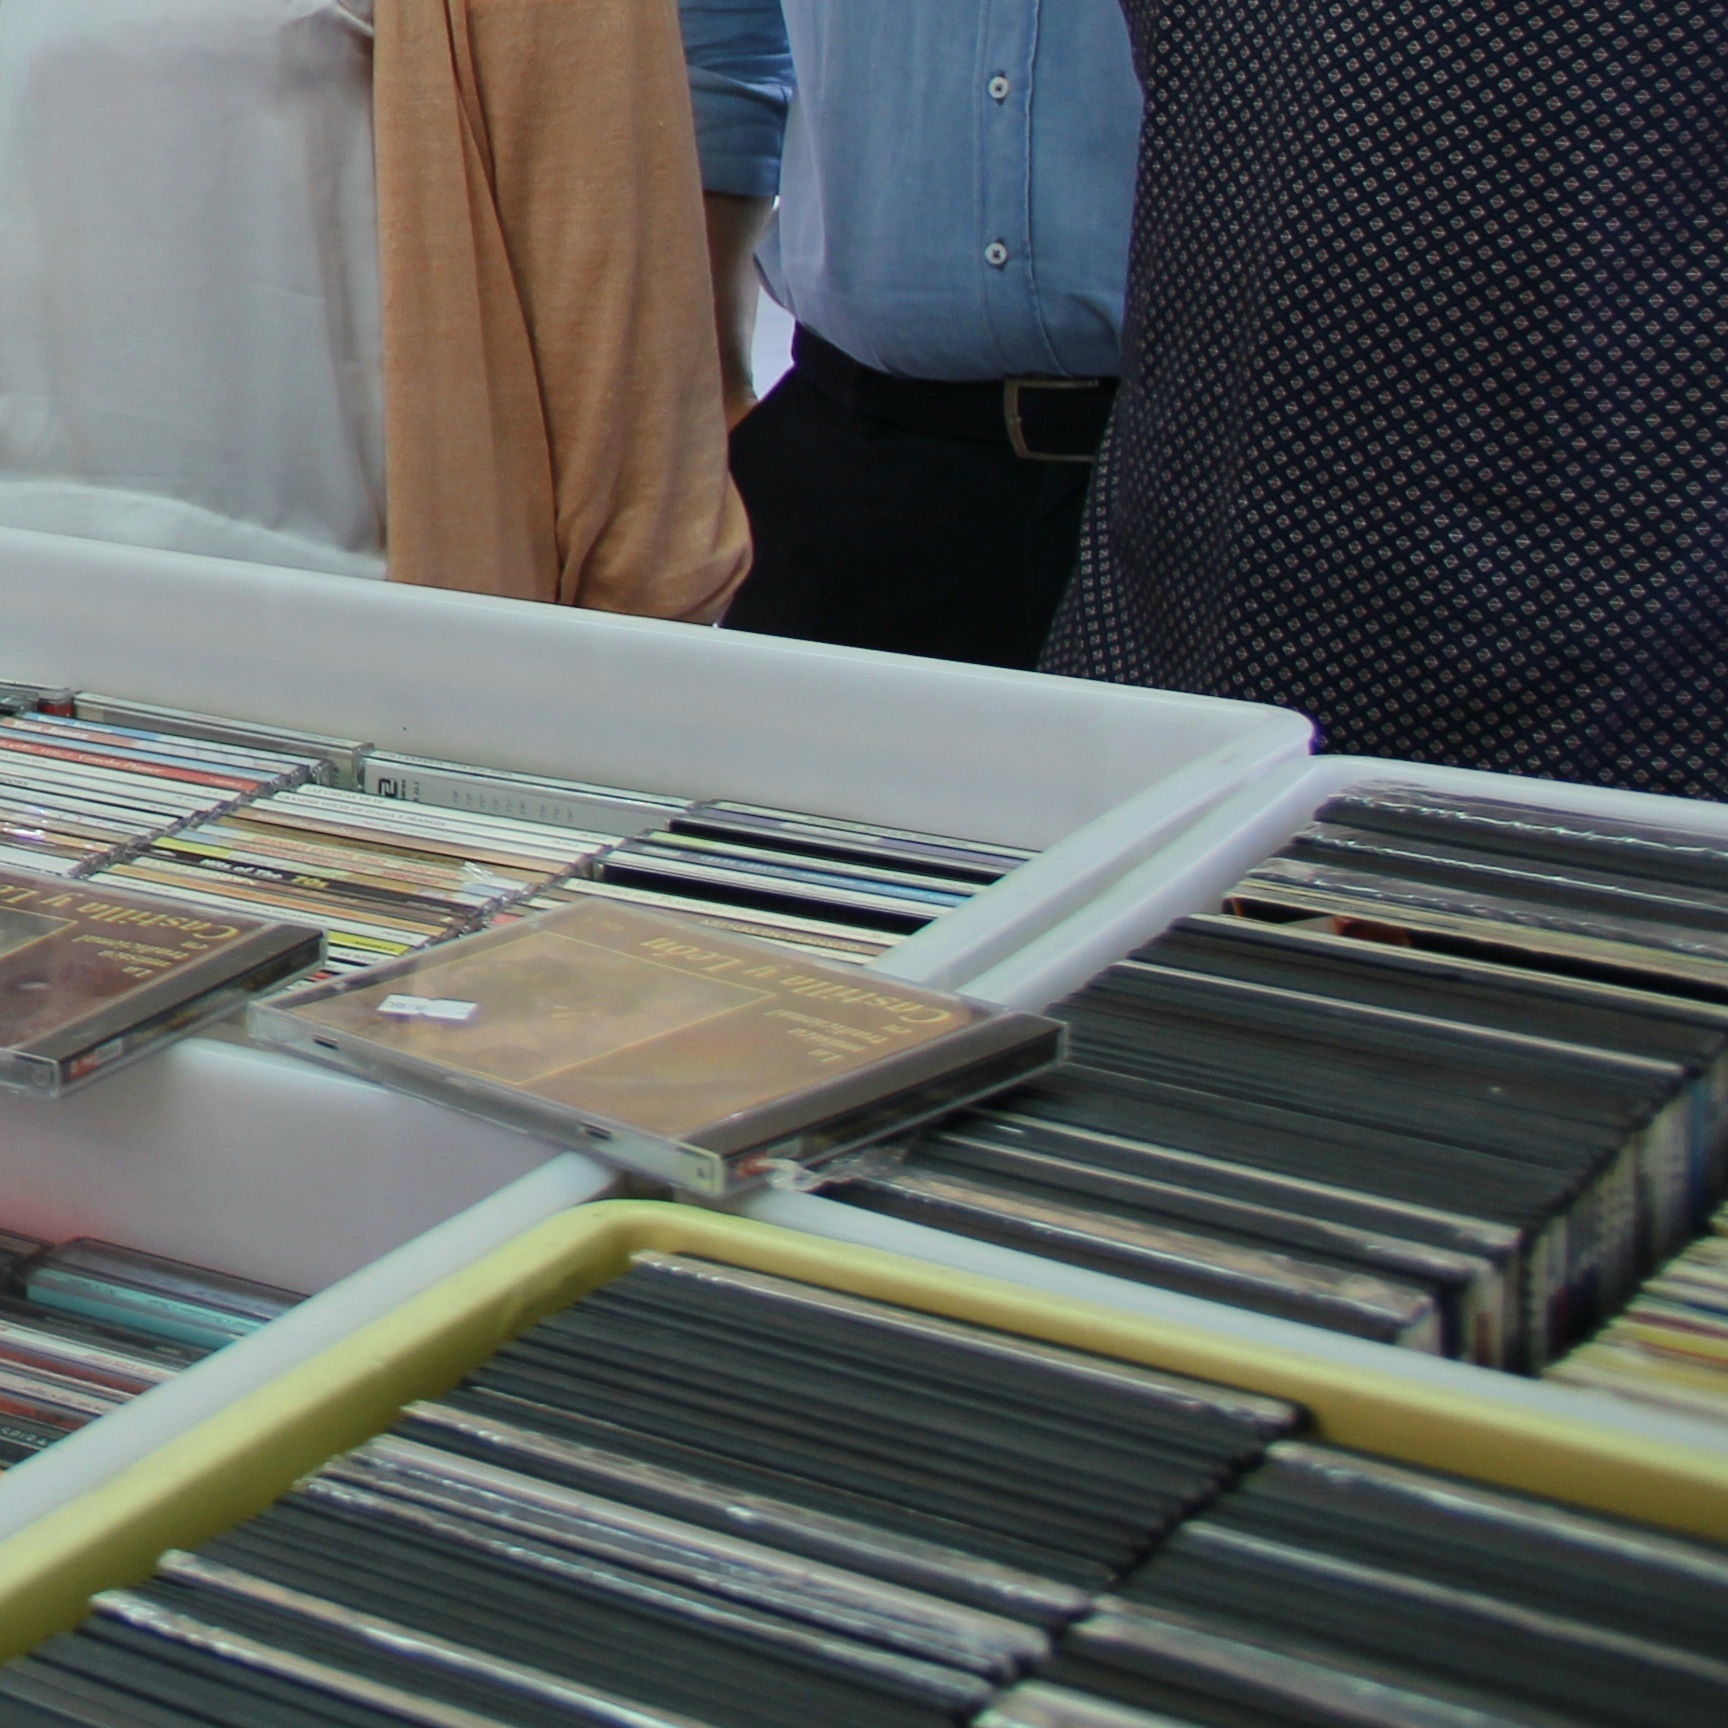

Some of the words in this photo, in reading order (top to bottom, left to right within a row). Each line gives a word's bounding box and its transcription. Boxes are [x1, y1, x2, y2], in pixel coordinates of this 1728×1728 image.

[40, 890, 86, 910] y
[76, 900, 244, 942] Castilla
[640, 935, 744, 973] León
[741, 962, 791, 979] y
[779, 975, 952, 1025] Castilla
